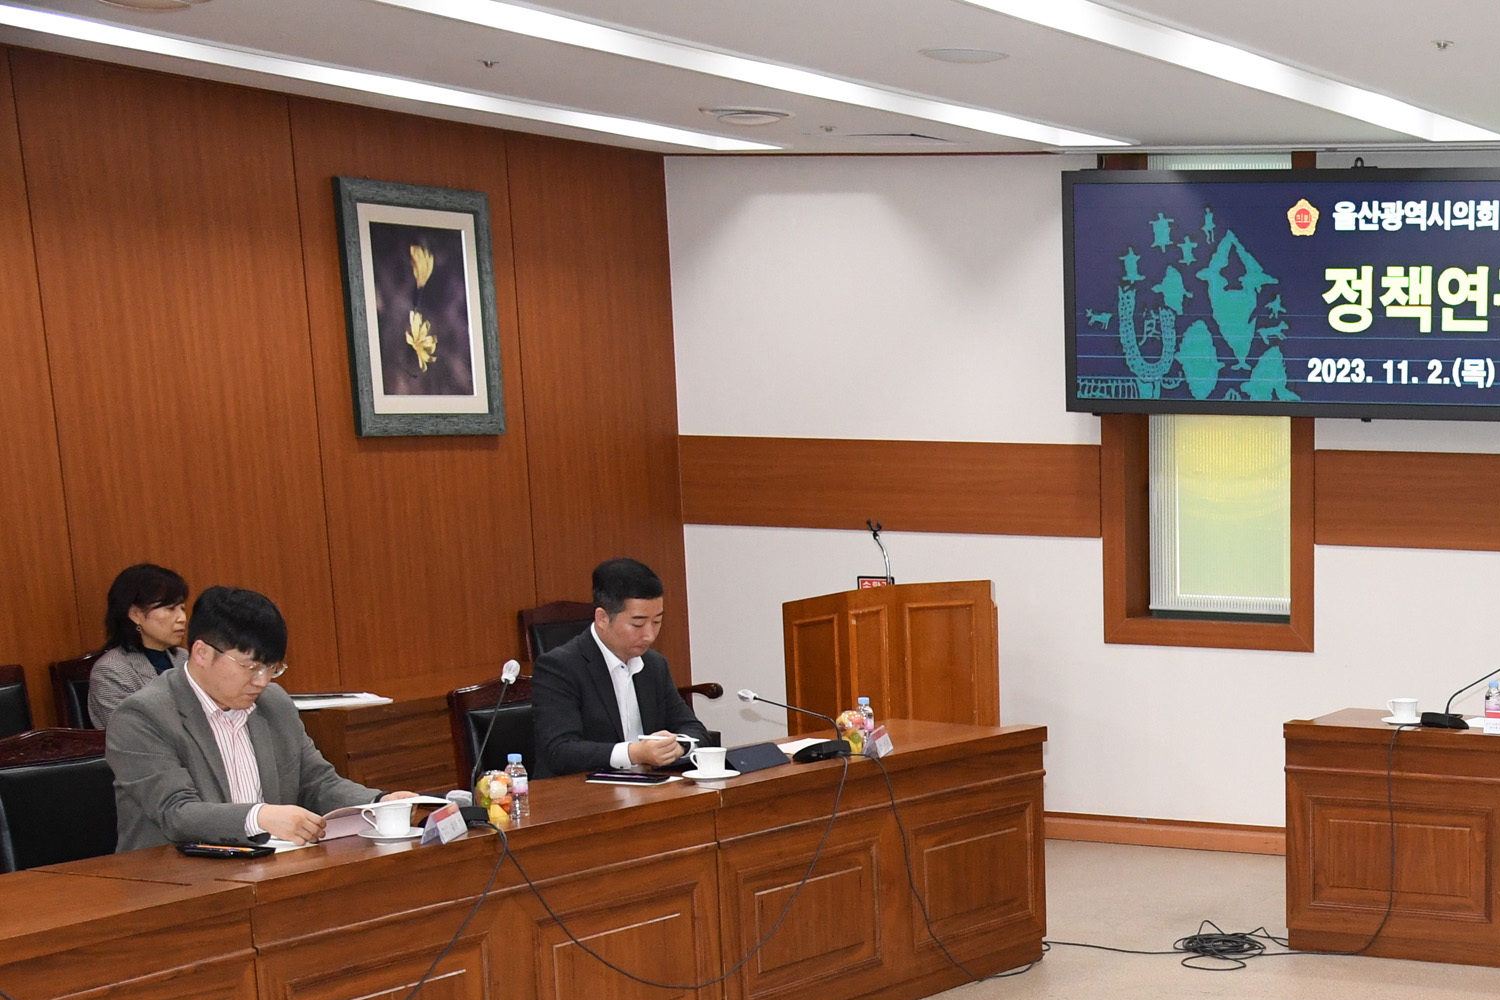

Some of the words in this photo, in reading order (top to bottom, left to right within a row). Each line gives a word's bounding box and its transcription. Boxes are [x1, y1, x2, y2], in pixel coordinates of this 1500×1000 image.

[1332, 199, 1500, 231] 울산광역시의회
[1307, 357, 1373, 384] 2023.
[1382, 359, 1419, 385] 11.
[1427, 357, 1495, 389] 2.(목)
